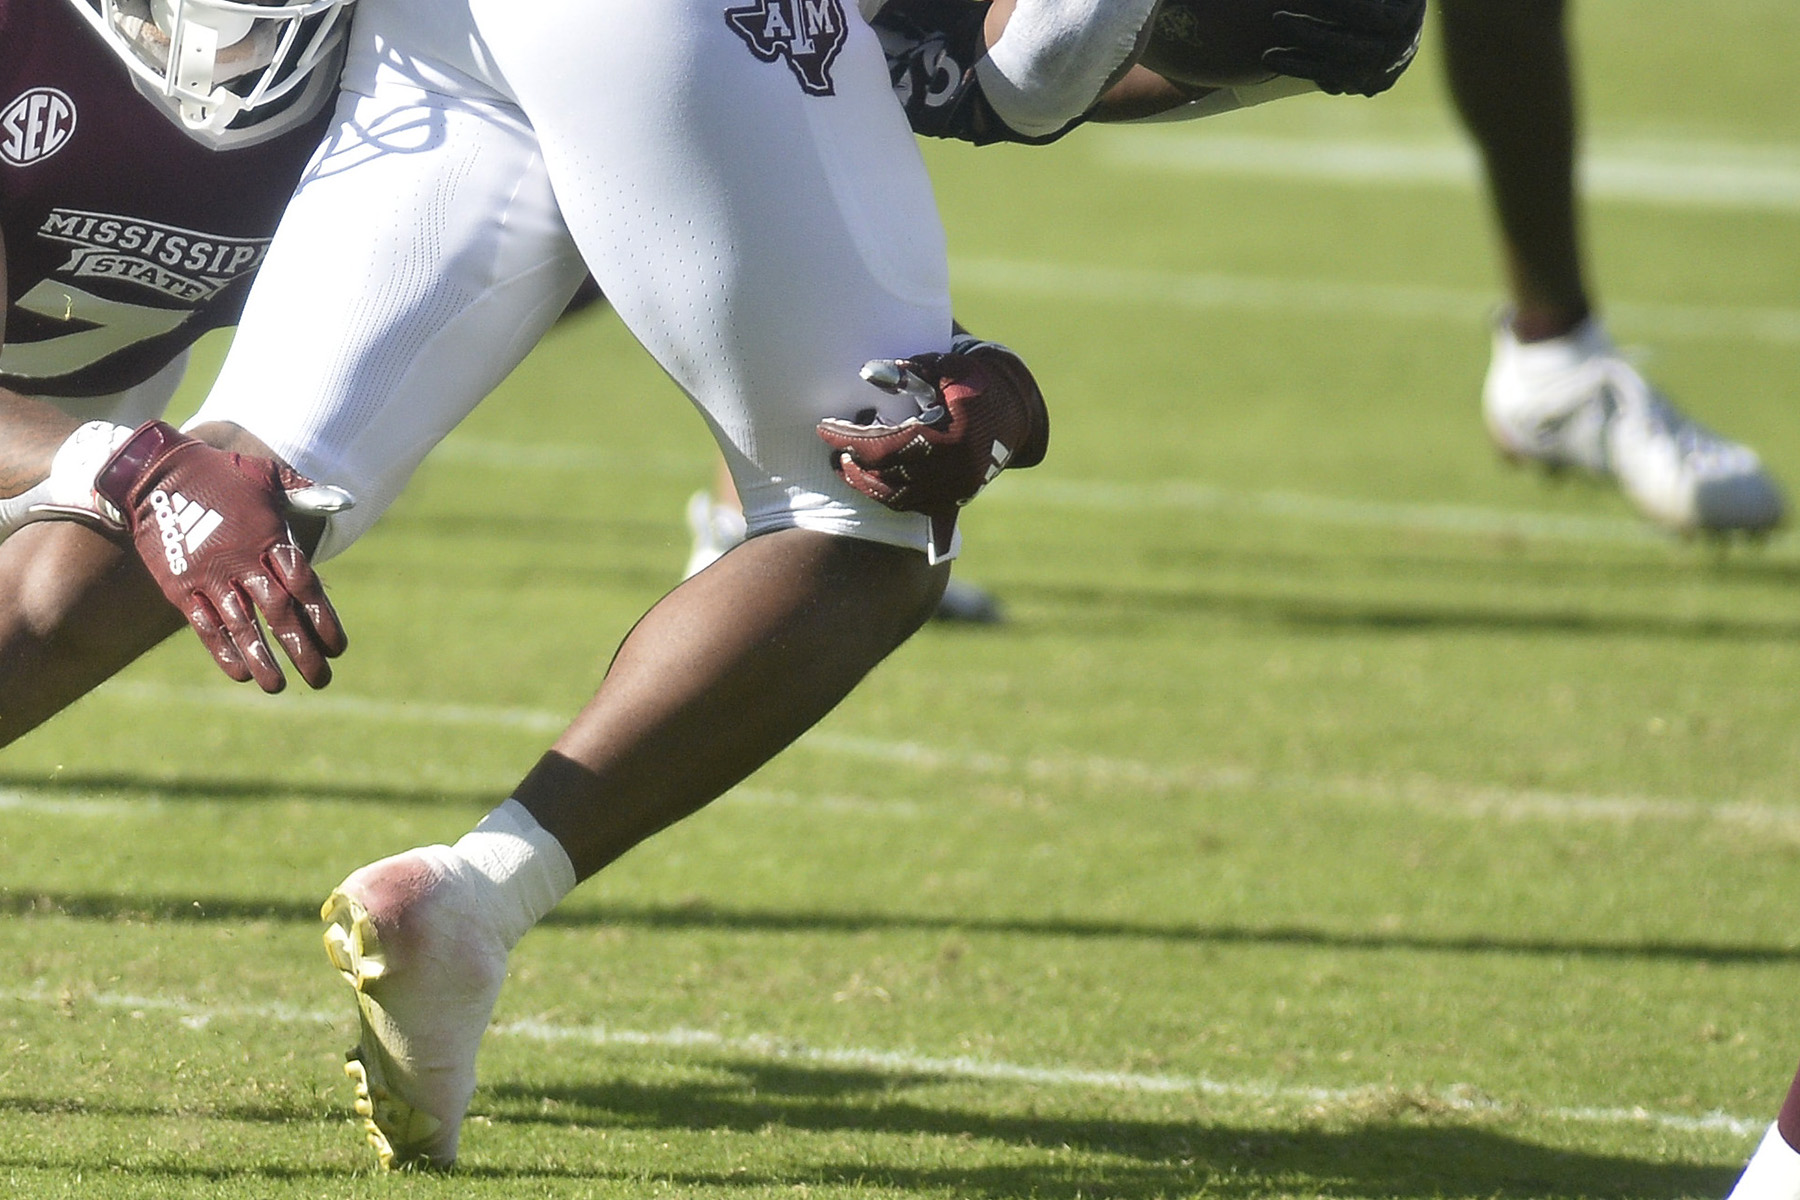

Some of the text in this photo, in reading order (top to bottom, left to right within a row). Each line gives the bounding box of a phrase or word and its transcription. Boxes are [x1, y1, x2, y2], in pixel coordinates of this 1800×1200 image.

[2, 93, 70, 161] SEC
[91, 257, 204, 299] STATE
[150, 489, 188, 576] adidas
